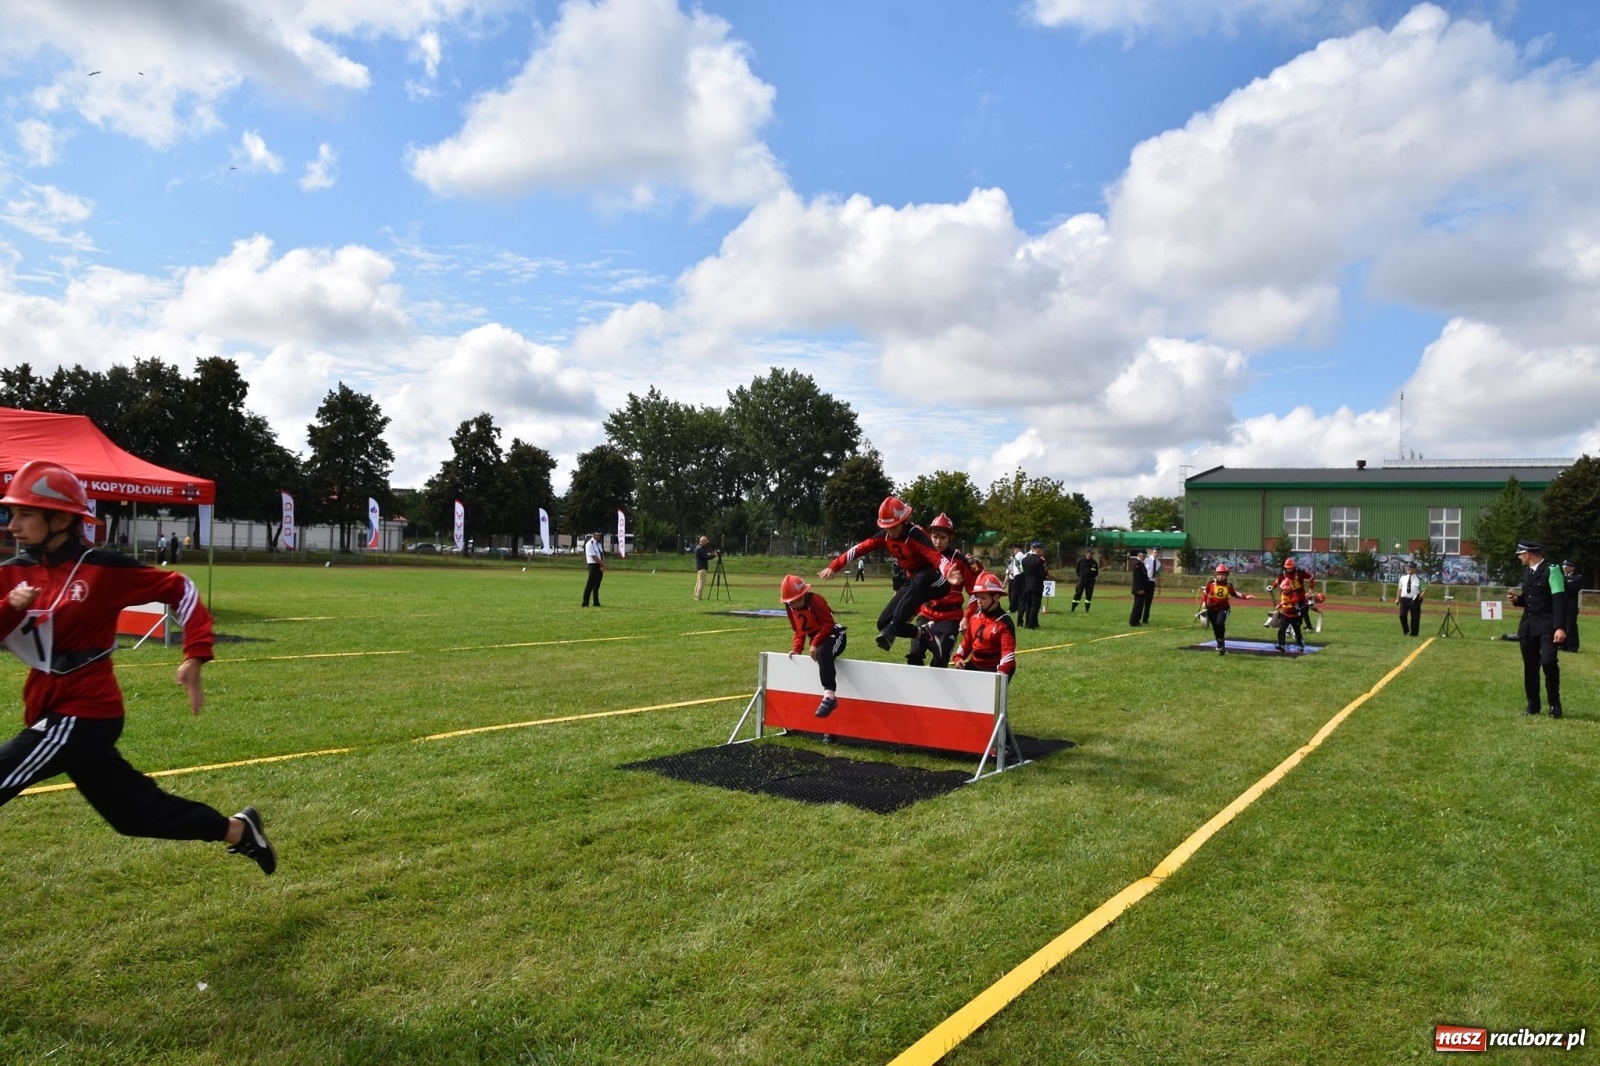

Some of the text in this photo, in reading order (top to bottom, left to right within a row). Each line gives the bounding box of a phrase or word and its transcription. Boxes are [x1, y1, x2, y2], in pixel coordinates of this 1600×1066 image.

[91, 480, 174, 496] KOPYDŁOWIE
[1045, 586, 1051, 596] 2
[1216, 587, 1224, 597] 8
[1488, 607, 1494, 619] 1
[797, 613, 813, 632] 2
[974, 623, 986, 644] 4
